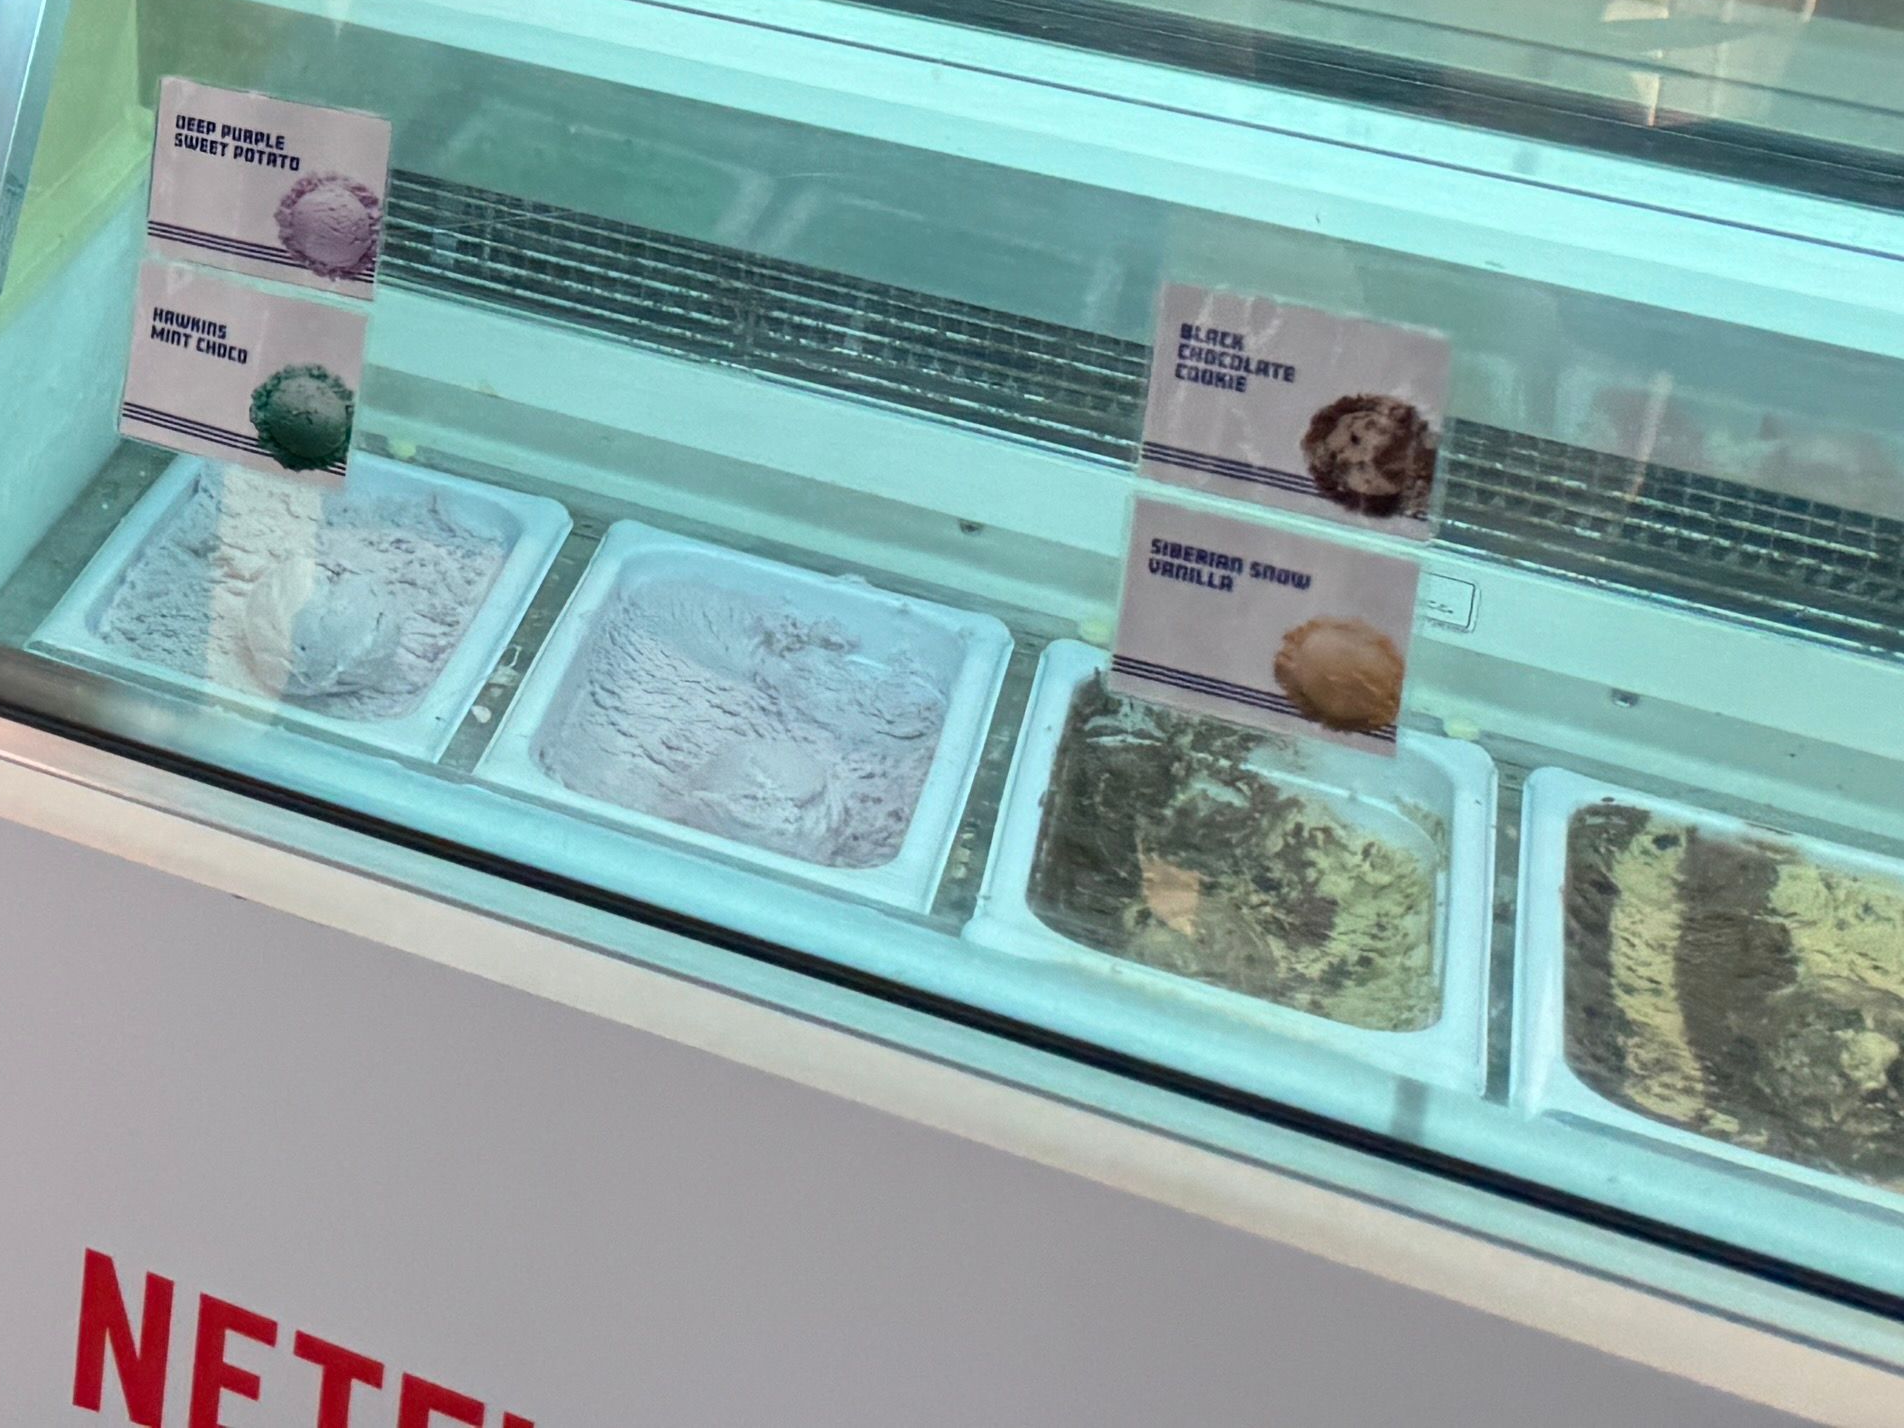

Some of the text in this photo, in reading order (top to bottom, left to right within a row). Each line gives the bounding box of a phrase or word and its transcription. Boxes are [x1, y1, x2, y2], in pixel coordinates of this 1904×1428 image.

[173, 132, 301, 172] SWEET POTATO
[175, 114, 286, 152] DEEP PURPLE
[152, 305, 228, 341] HAWKINS
[1179, 322, 1245, 352] BLACK
[149, 323, 249, 366] MINT CHOCO
[1176, 342, 1297, 384] CHOCOLATE
[1174, 362, 1248, 393] COOKIE
[1147, 557, 1235, 593] VANILLA
[1149, 537, 1313, 592] SIBERIAN SNOW
[72, 1246, 537, 1428] NET
